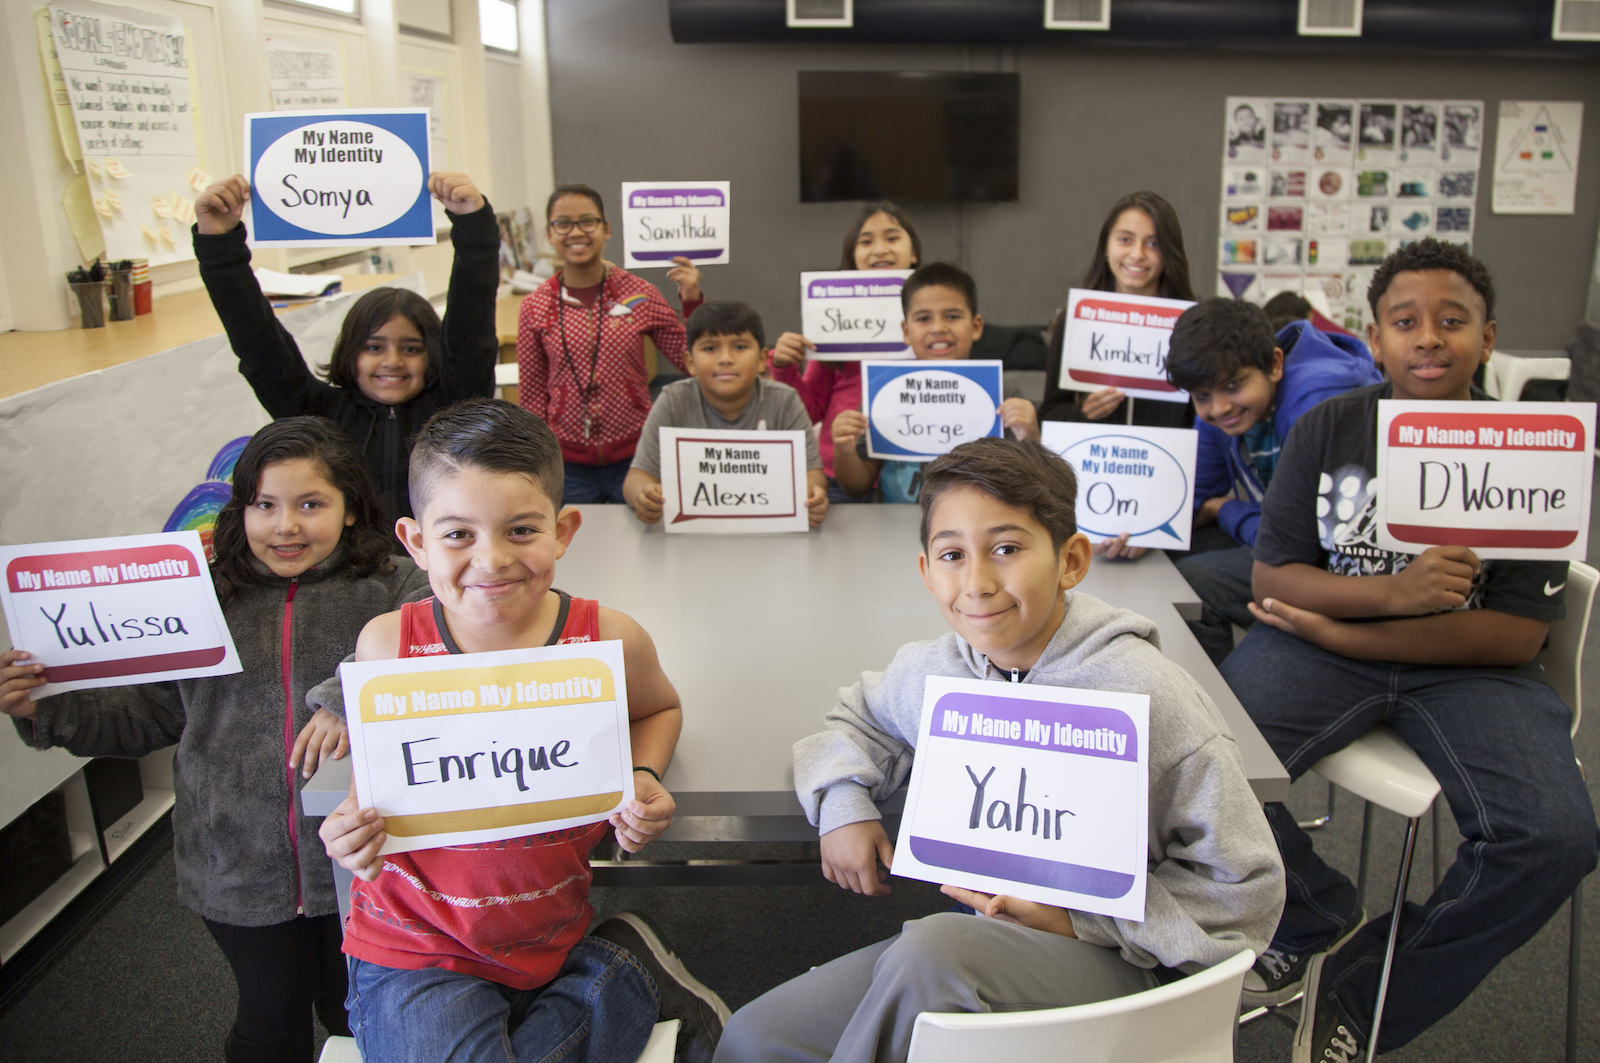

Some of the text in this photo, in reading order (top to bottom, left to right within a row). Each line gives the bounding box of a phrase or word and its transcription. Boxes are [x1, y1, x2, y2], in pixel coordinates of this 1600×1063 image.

[303, 129, 374, 146] My Name
[294, 147, 383, 164] My Identity
[280, 174, 373, 219] Somya
[633, 194, 722, 208] My Name My Identity
[640, 213, 716, 241] Sawithda
[812, 285, 826, 297] My
[827, 285, 854, 296] Name
[854, 284, 868, 297] My
[821, 307, 886, 338] Stacey
[1080, 305, 1097, 320] My
[1098, 308, 1128, 323] Name
[1129, 311, 1145, 326] My
[906, 378, 959, 391] My Name
[900, 391, 966, 405] My Identity
[898, 413, 965, 444] Jorge
[1398, 425, 1577, 449] My Name My Identity
[704, 447, 760, 461] My Name
[1090, 444, 1149, 461] My Name
[699, 461, 768, 475] My Identity
[1082, 459, 1155, 478] My Identity
[692, 481, 769, 507] Alexis
[1086, 481, 1139, 516] Om
[1419, 461, 1566, 514] D'Wonne
[16, 558, 189, 591] My Name My Identity
[39, 601, 189, 649] Yulissa
[374, 676, 602, 716] My Name My Identity
[942, 709, 1128, 756] My Name My Identity
[401, 736, 580, 792] Enrique
[965, 765, 1077, 841] Yahir
